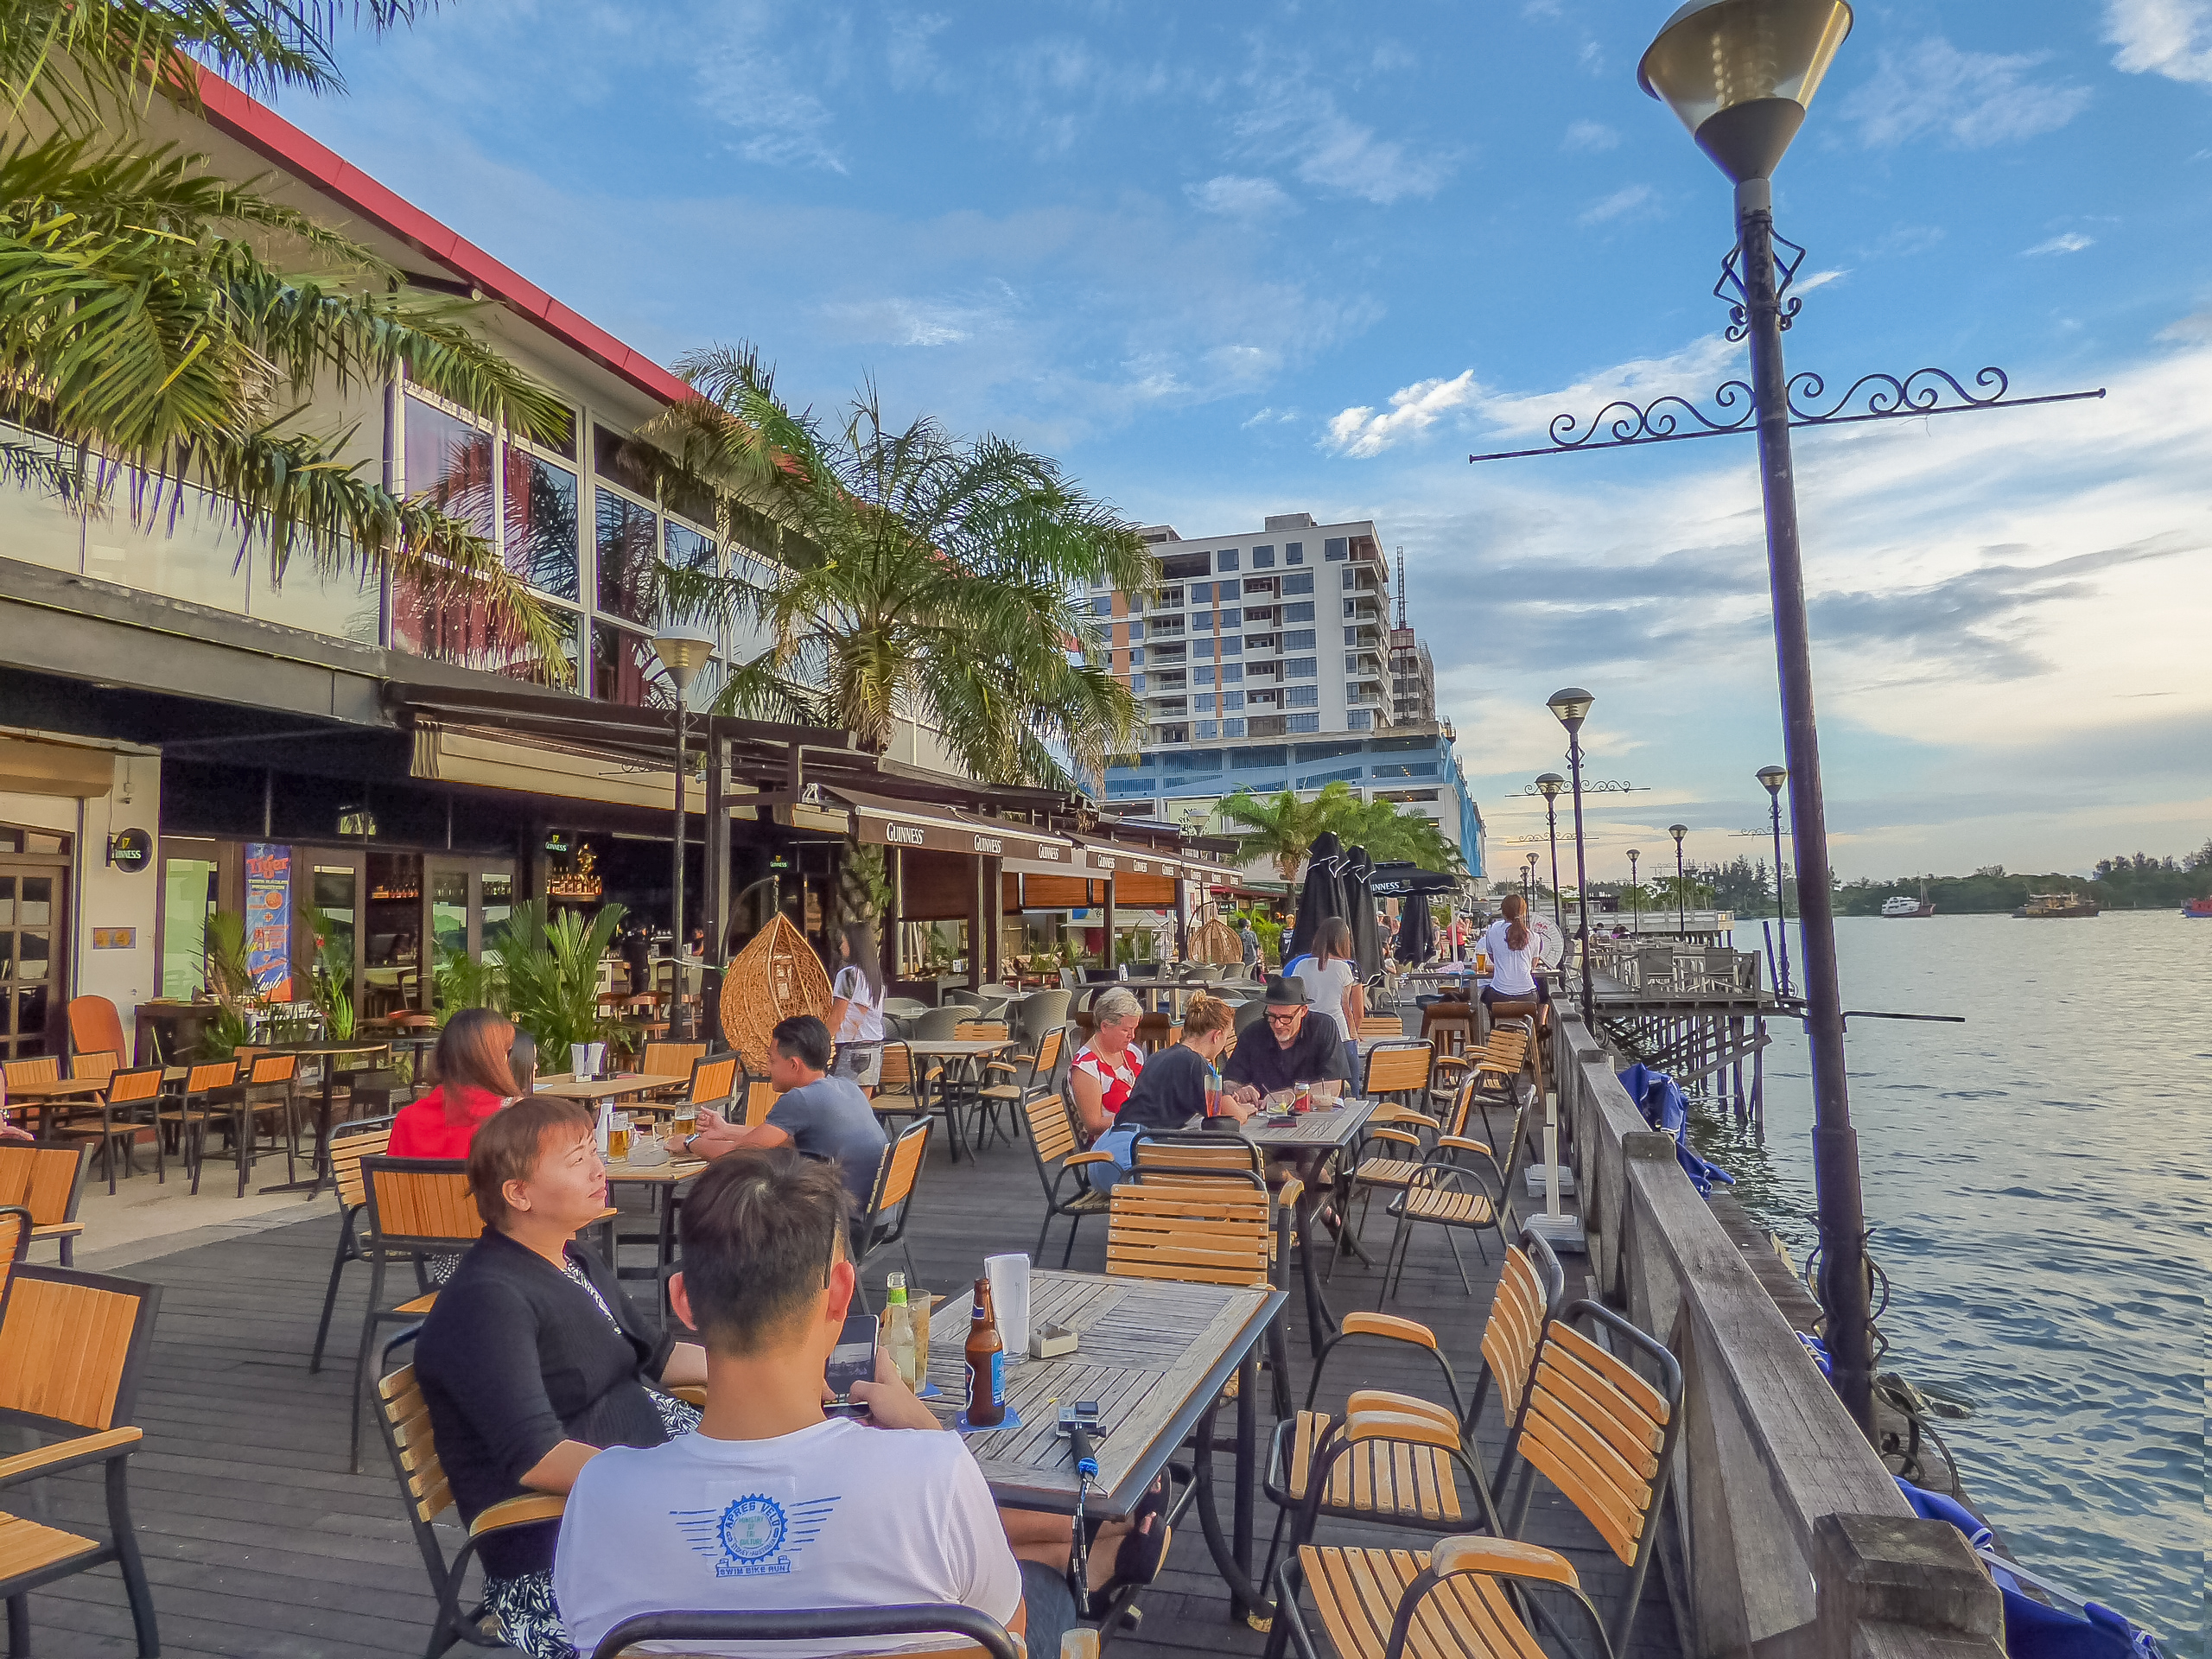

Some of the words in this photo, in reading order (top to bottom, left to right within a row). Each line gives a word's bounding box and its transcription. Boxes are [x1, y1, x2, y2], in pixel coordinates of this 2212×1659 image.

[886, 822, 924, 845] GUINNESS
[974, 834, 1001, 854] GUINNESS
[1038, 843, 1059, 861] GUINNESS
[246, 854, 289, 879] Tiger
[1370, 881, 1400, 892] INNESS
[745, 1566, 766, 1574] BIKE
